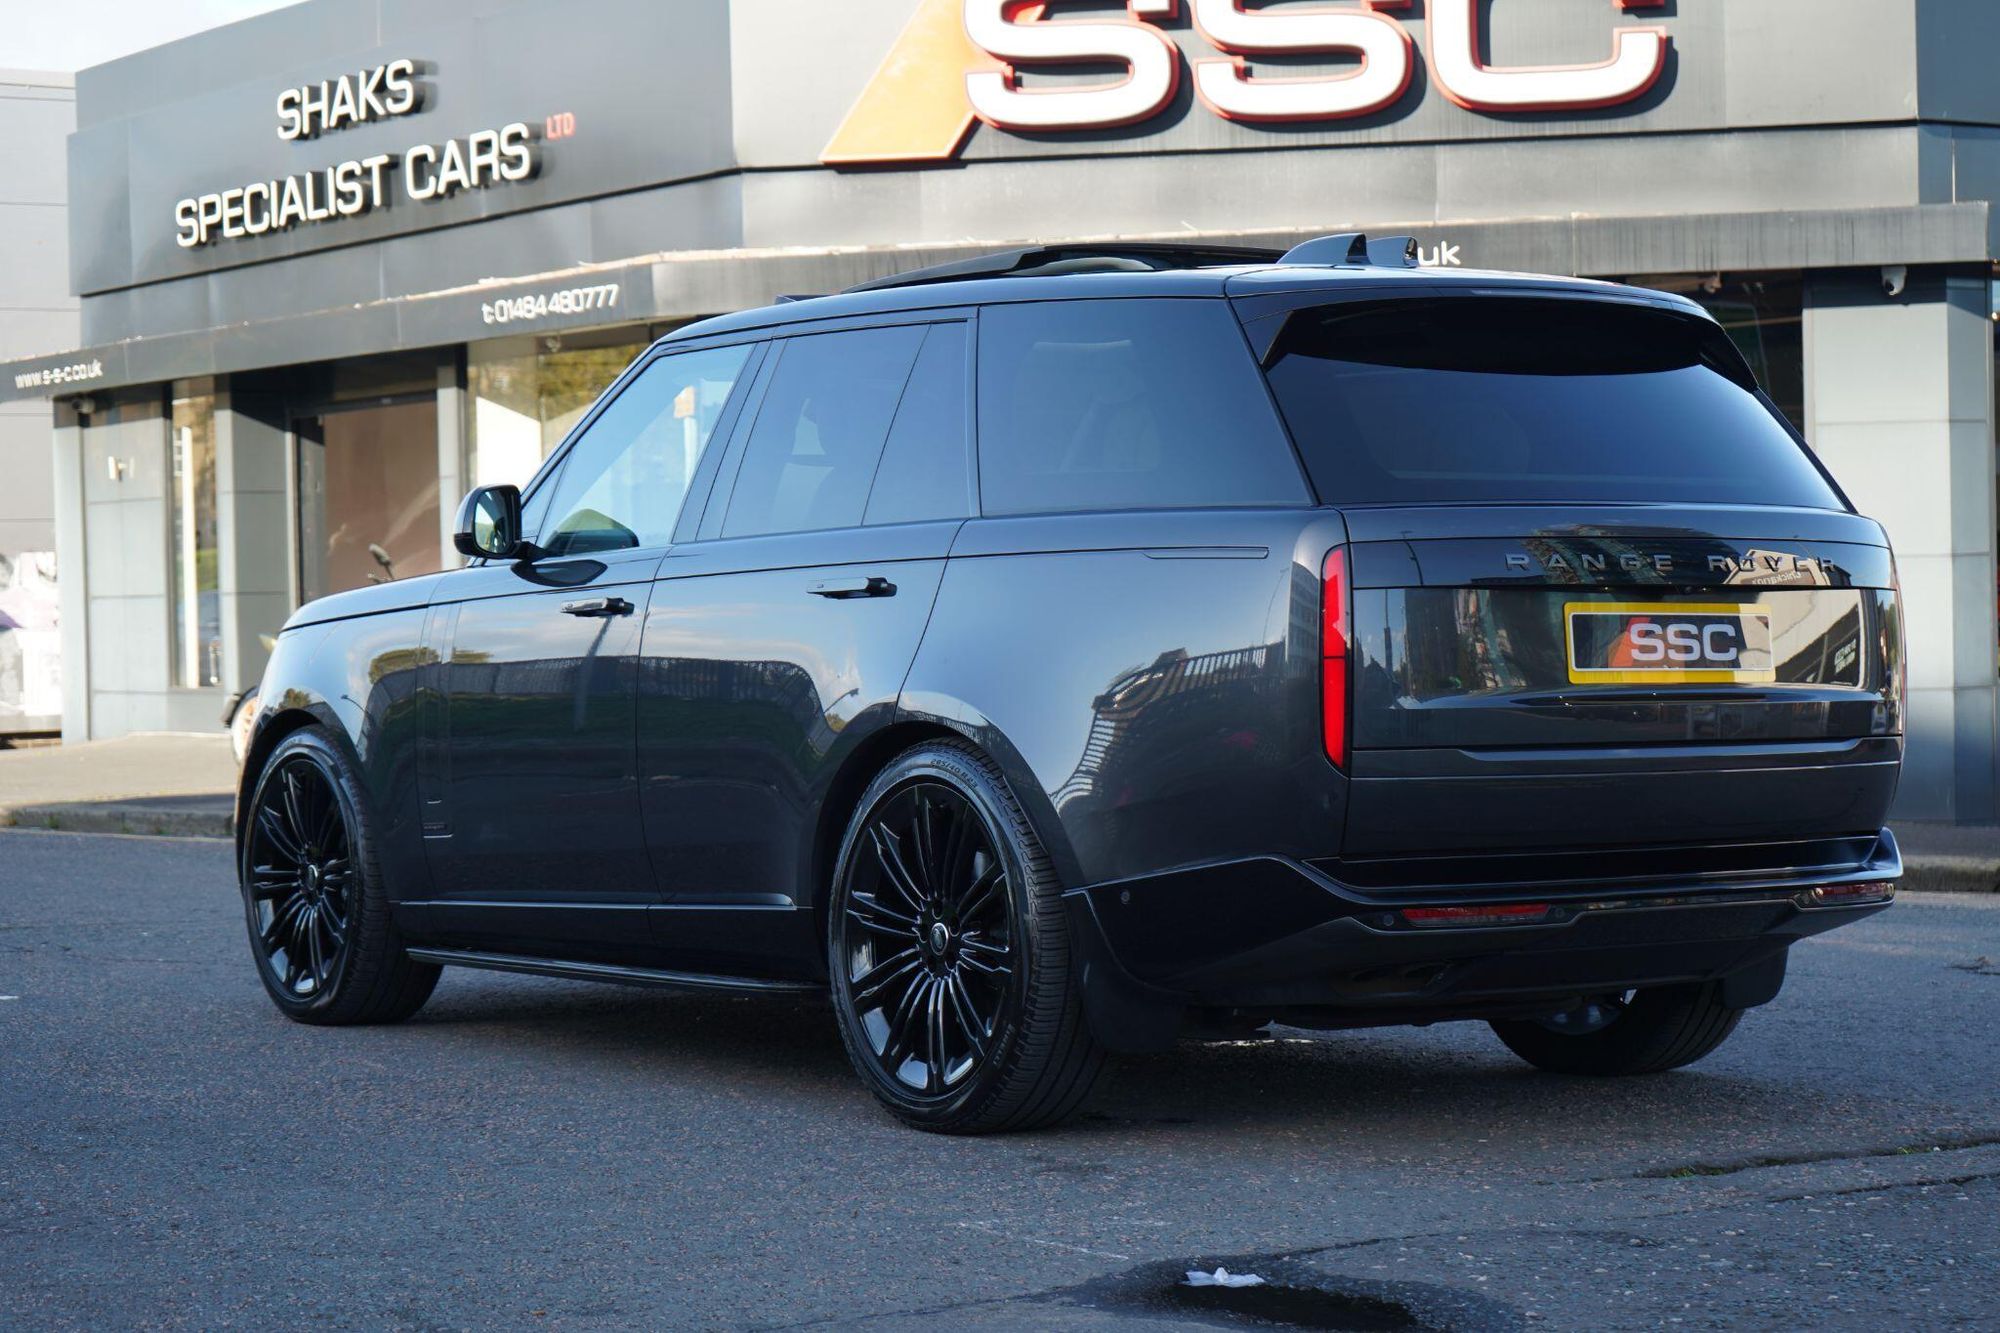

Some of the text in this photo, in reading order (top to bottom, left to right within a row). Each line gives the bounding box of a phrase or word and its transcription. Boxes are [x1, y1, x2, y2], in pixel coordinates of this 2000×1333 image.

[963, 0, 1667, 132] SSC
[276, 58, 415, 140] SHAKS
[174, 112, 576, 248] SPECIALIST CARS LTD
[547, 283, 620, 315] 480777
[1504, 552, 1834, 572] RANGE ROVER
[1630, 623, 1738, 661] SSC
